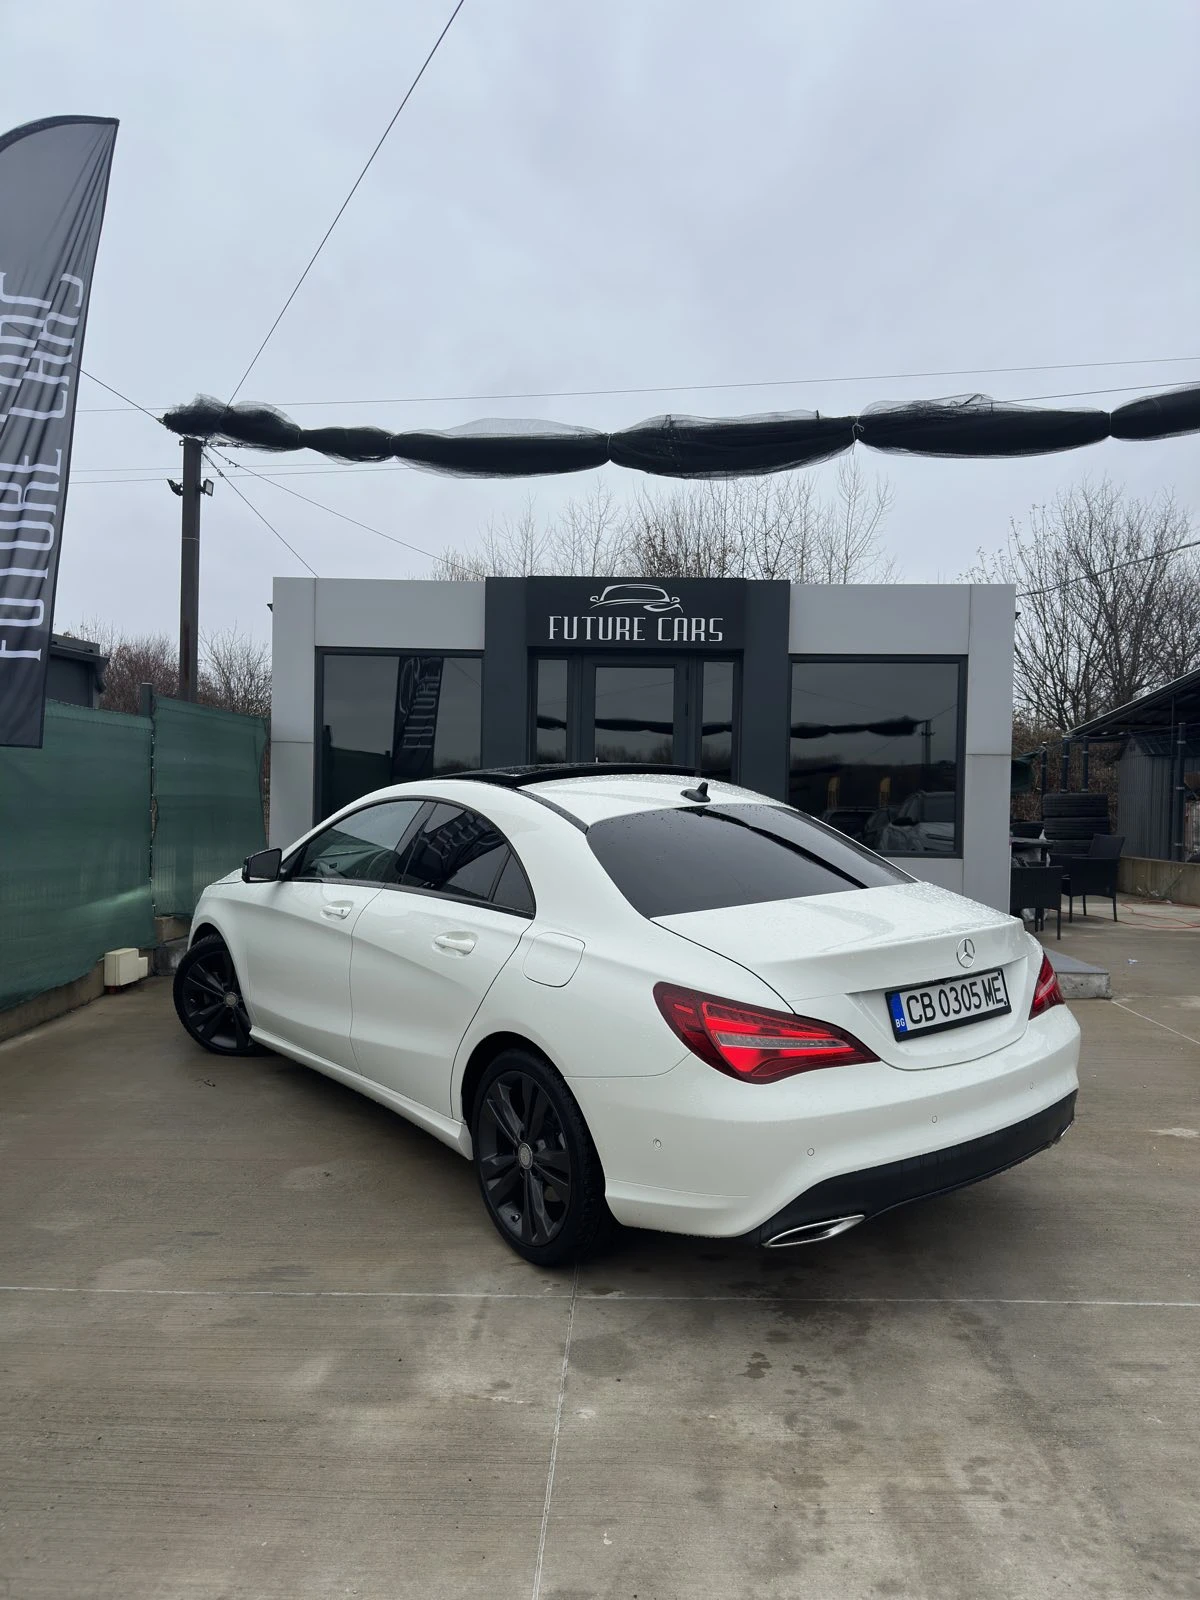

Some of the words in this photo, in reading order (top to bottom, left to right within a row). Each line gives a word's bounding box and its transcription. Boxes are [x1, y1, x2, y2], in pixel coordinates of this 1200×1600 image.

[548, 616, 646, 641] FUTURE
[657, 617, 724, 642] CARS
[895, 1018, 906, 1028] BG
